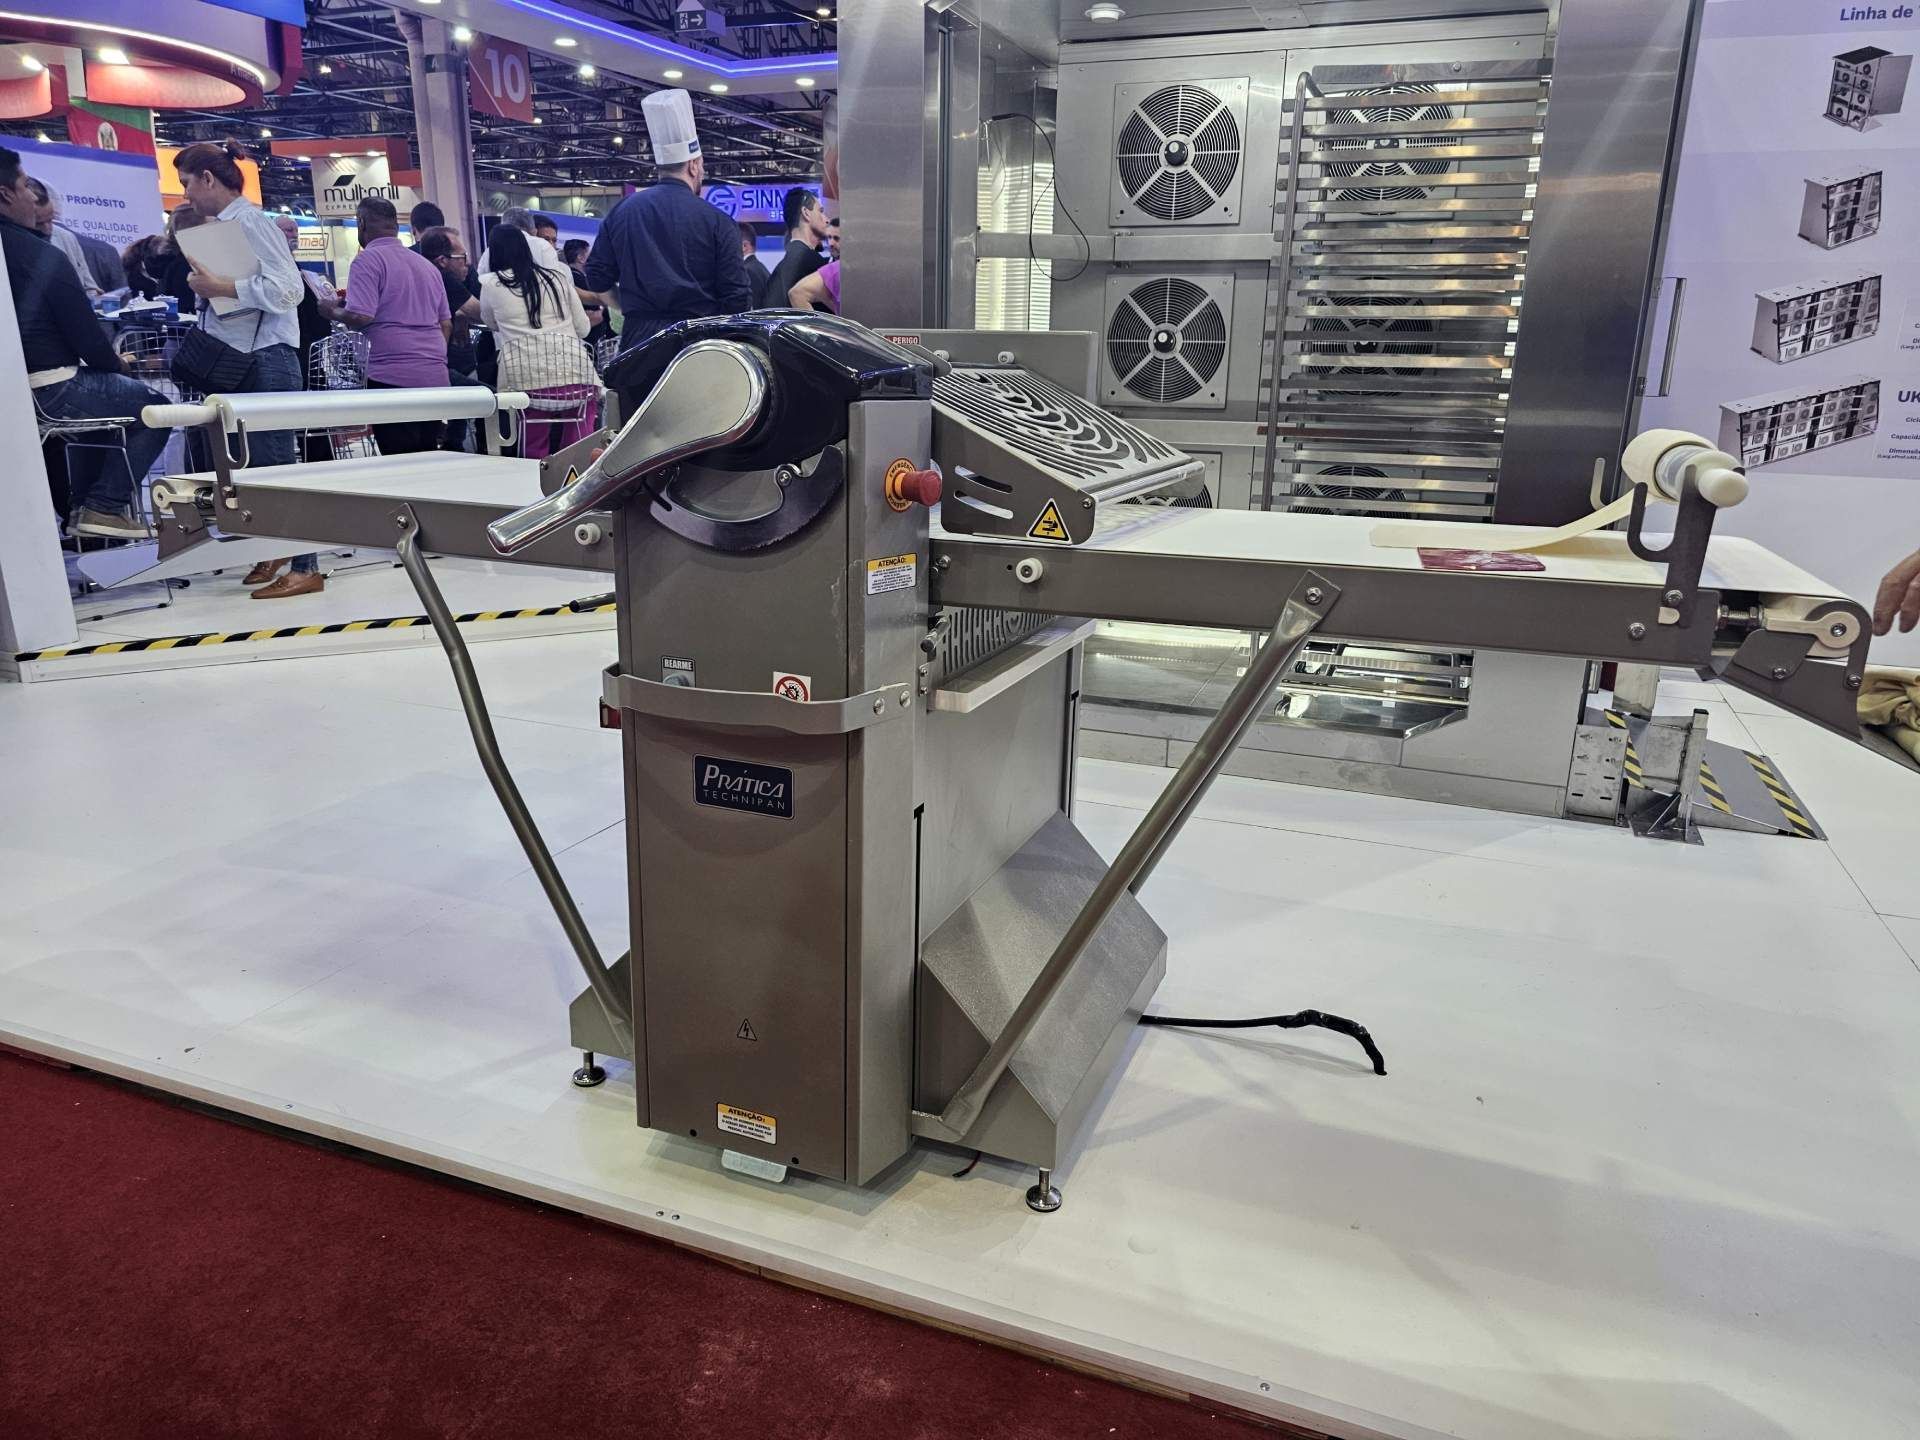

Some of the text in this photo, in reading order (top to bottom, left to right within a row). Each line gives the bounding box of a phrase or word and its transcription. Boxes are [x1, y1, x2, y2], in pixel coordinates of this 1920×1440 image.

[1840, 5, 1913, 21] Linha de
[485, 48, 526, 104] 10
[66, 194, 126, 209] PROPÓSITO
[82, 220, 140, 234] QUALIDADE
[892, 336, 918, 345] PERIGO
[664, 658, 693, 671] REARME
[703, 789, 785, 810] TECHNIPAN
